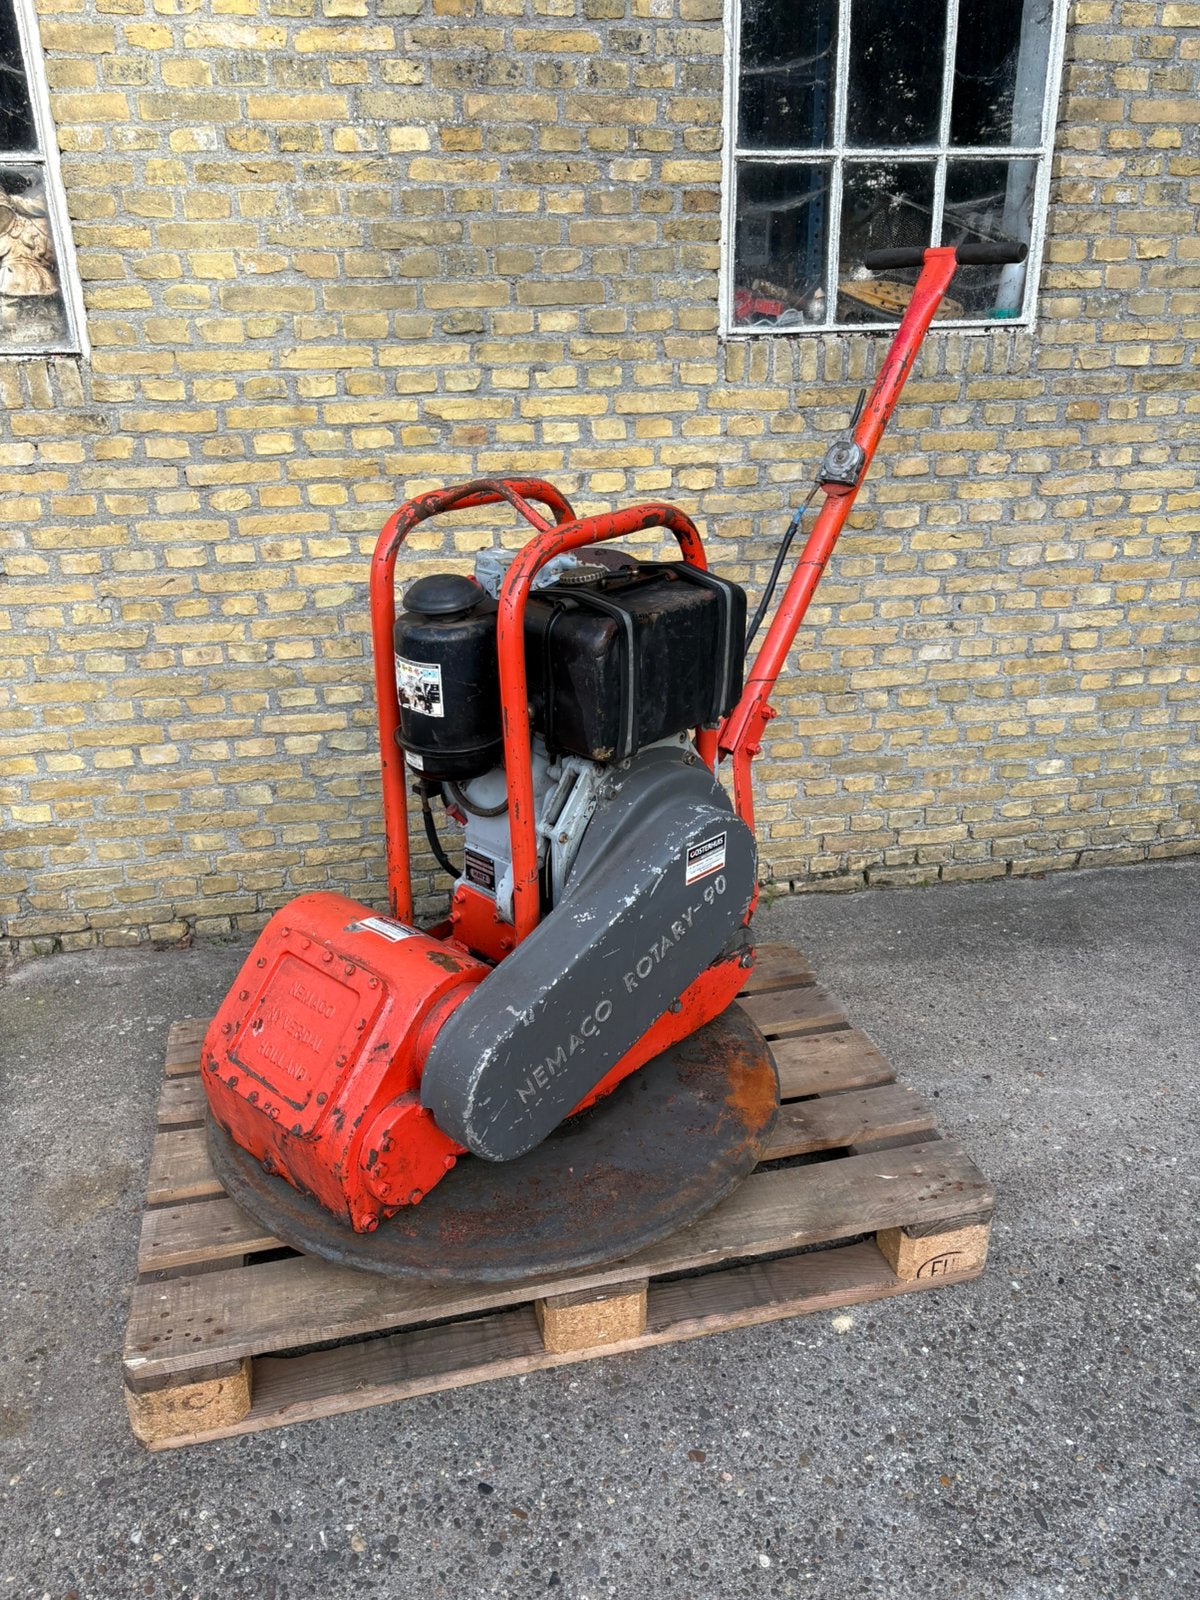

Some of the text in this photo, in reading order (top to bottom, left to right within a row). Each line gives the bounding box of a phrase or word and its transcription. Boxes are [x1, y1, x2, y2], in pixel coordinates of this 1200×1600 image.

[289, 981, 337, 1020] NEMACO
[256, 1037, 308, 1082] HOLLAND
[515, 998, 613, 1106] NEMACO
